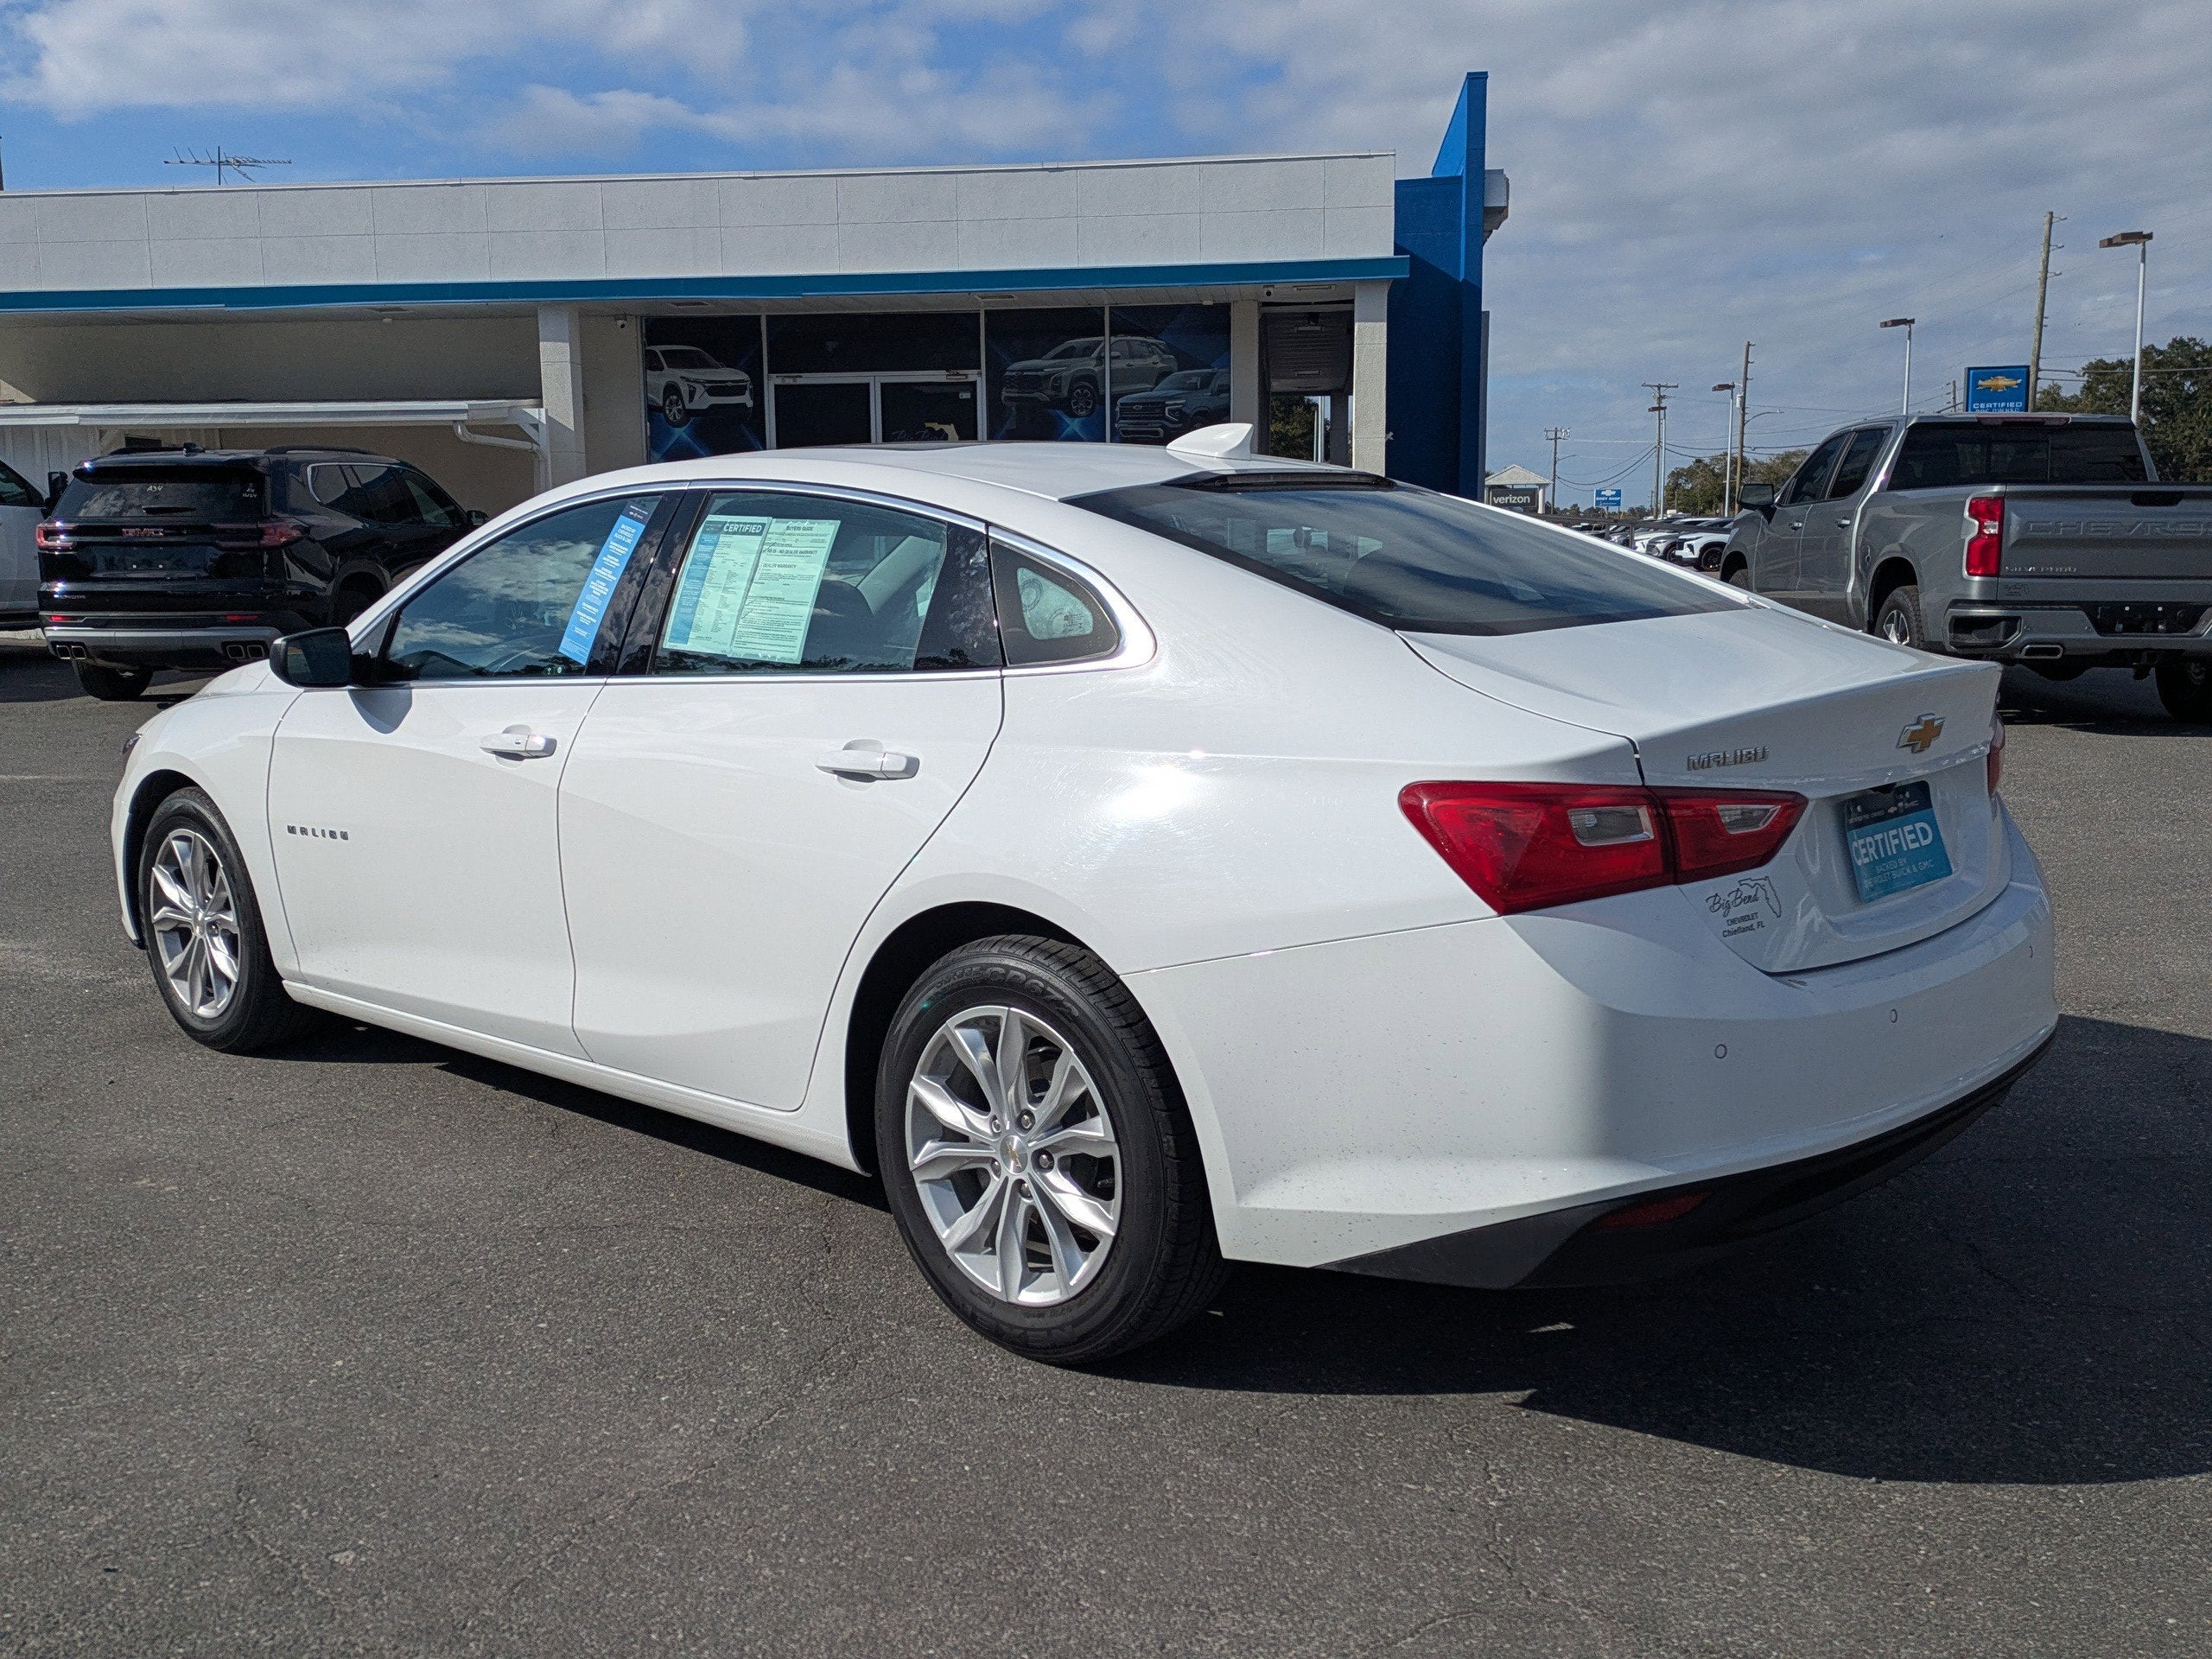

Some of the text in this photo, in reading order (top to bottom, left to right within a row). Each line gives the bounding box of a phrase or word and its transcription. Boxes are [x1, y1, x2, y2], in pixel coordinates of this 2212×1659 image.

[1493, 494, 1530, 504] verizon
[723, 524, 762, 533] CERTIFIED
[2029, 522, 2212, 535] CHEVRO
[1688, 747, 1769, 771] MALIBU
[287, 825, 348, 840] MALIBU
[1852, 822, 1933, 866] CERTIFIED
[1706, 887, 1759, 918] Big Bend
[1756, 920, 1765, 929] FL
